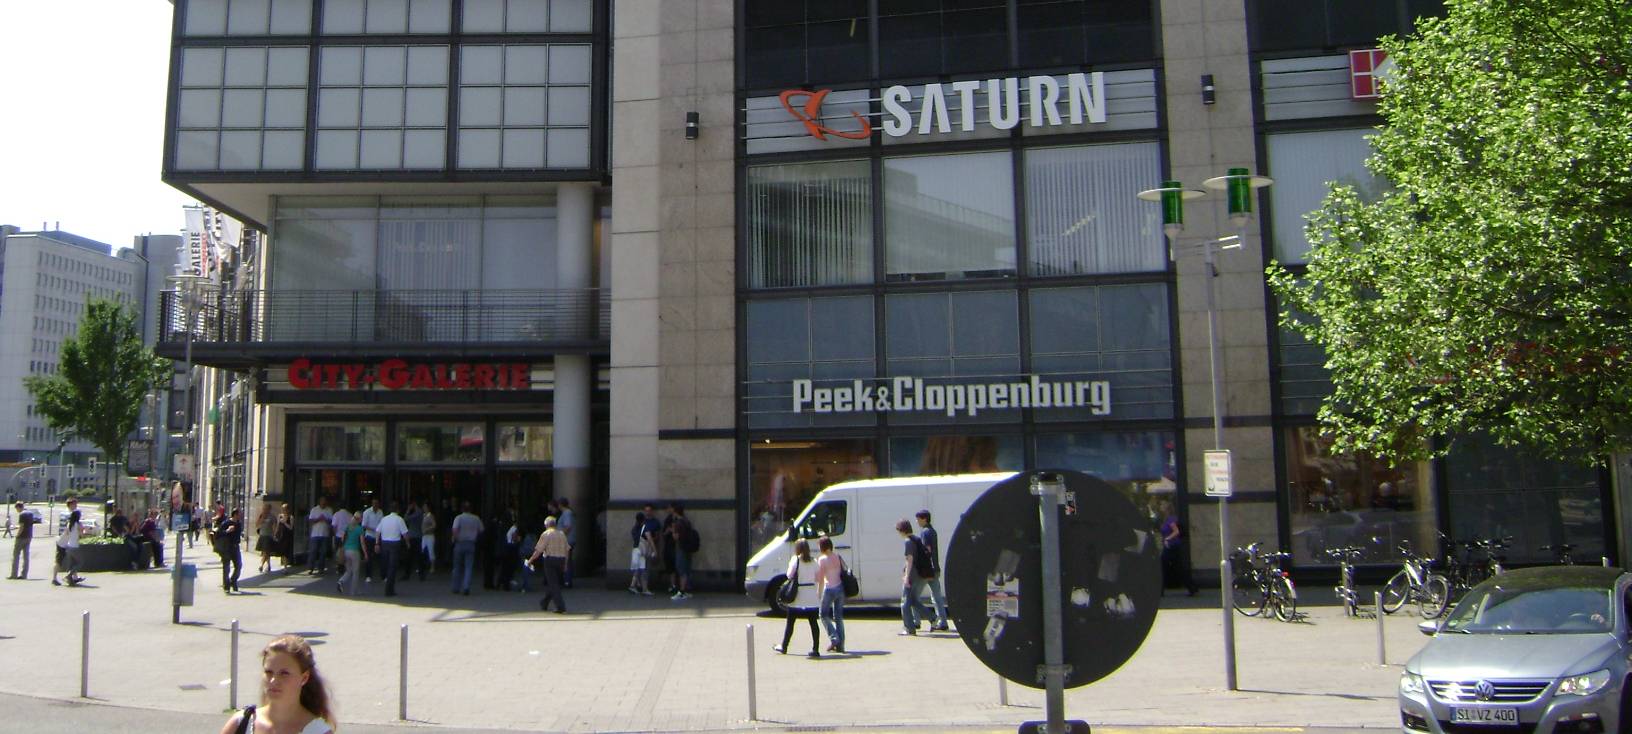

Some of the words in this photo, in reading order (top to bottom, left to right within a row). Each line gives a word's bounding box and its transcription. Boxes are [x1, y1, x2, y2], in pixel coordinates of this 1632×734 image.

[883, 71, 1106, 137] SATURN
[793, 375, 1111, 416] Peek&Cloppenburg
[1477, 708, 1491, 720] VZ
[1494, 709, 1515, 721] 400
